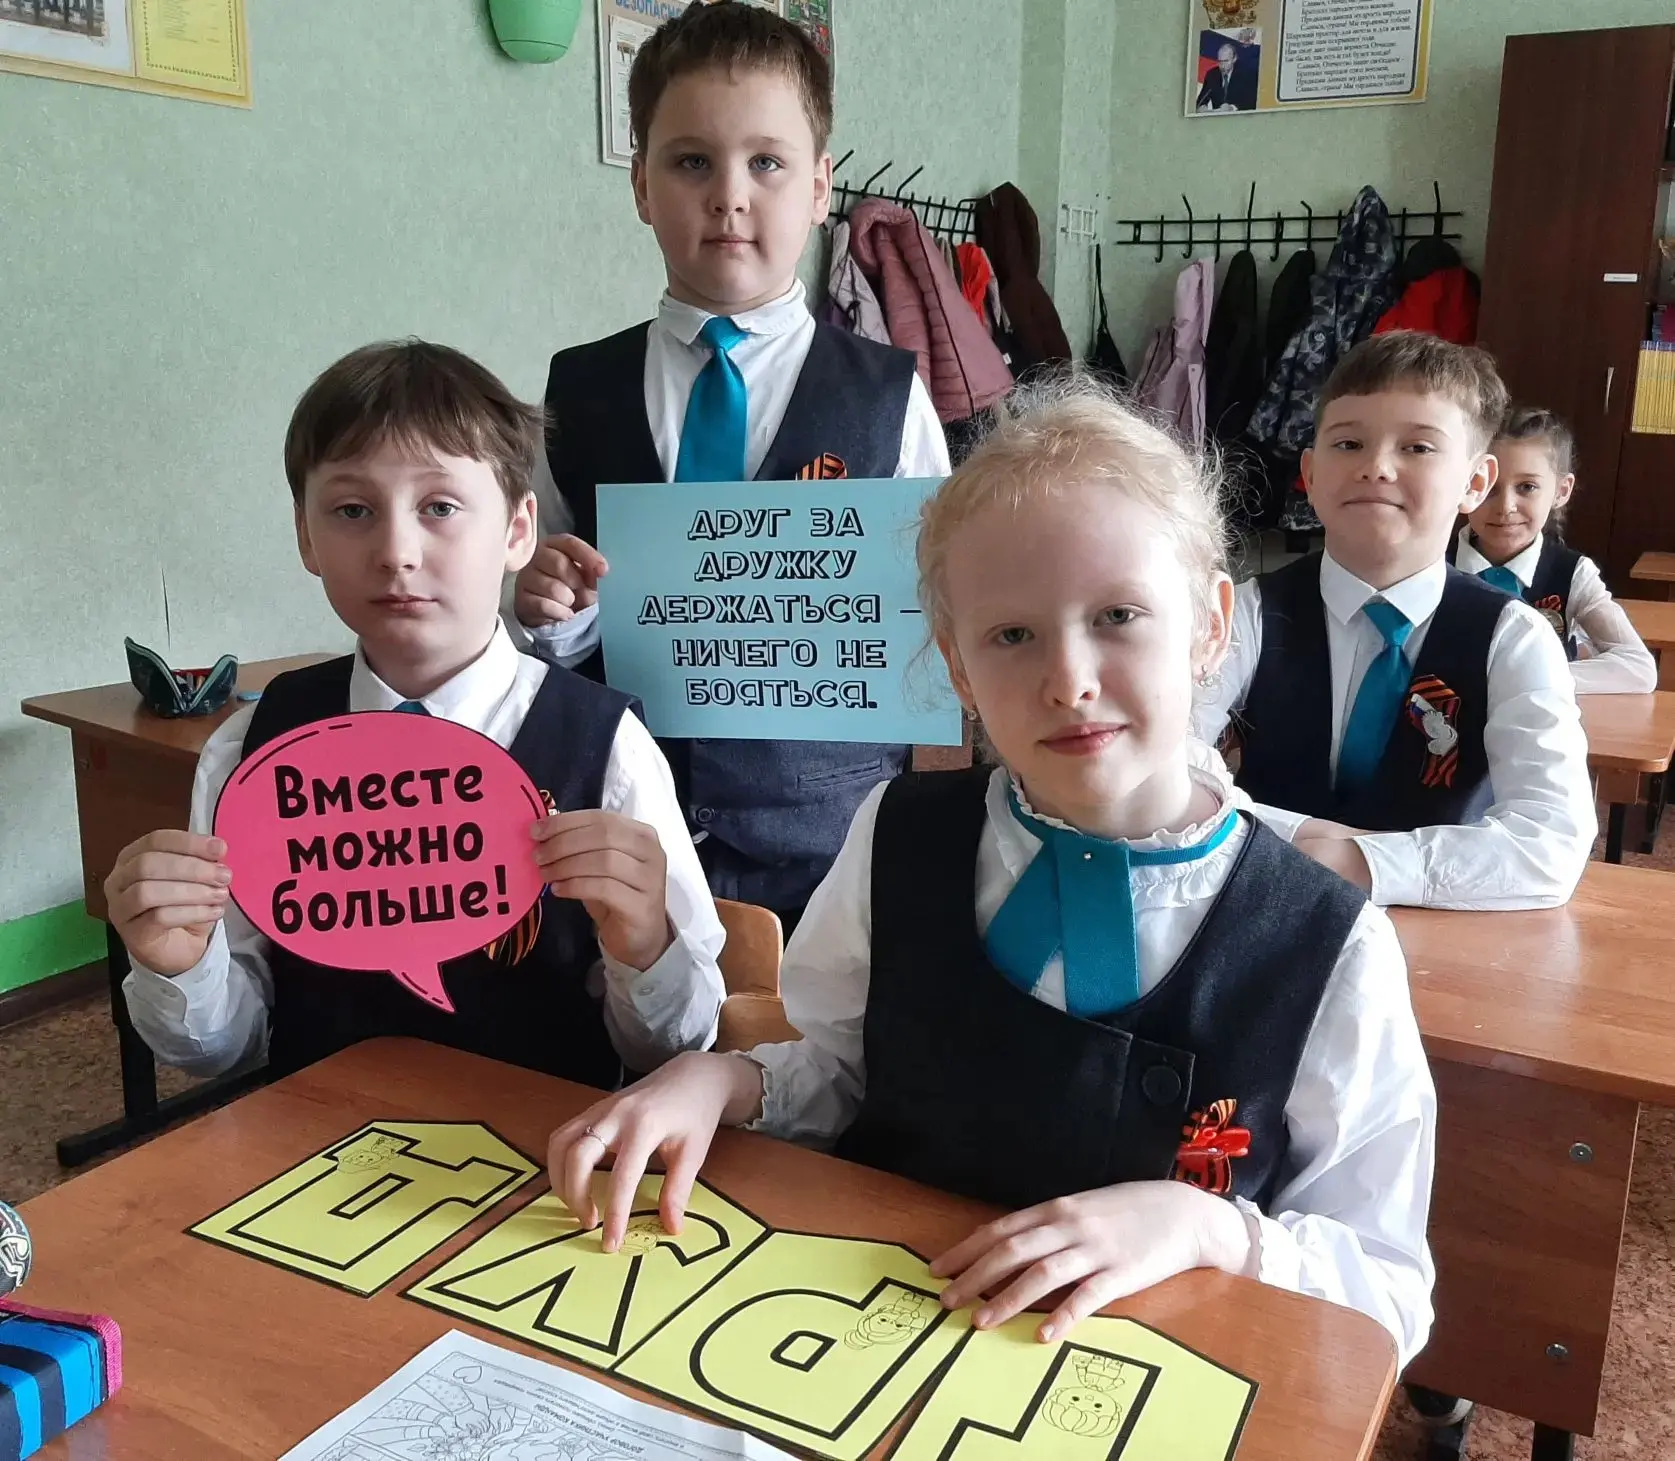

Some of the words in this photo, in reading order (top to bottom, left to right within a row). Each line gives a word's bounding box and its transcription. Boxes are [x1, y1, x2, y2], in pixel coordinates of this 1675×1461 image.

[688, 508, 791, 541] ДРУГ
[810, 507, 865, 537] ЗА
[694, 550, 857, 582] ДРУЖКУ
[637, 594, 881, 625] ДЕРЖАТЬСЯ
[672, 639, 818, 668] НИЧЕГО
[837, 639, 888, 669] НЕ
[685, 678, 879, 709] БОЯТЬСЯ.
[273, 764, 484, 819] Вместе
[286, 821, 484, 874] можно
[271, 864, 511, 935] больше!
